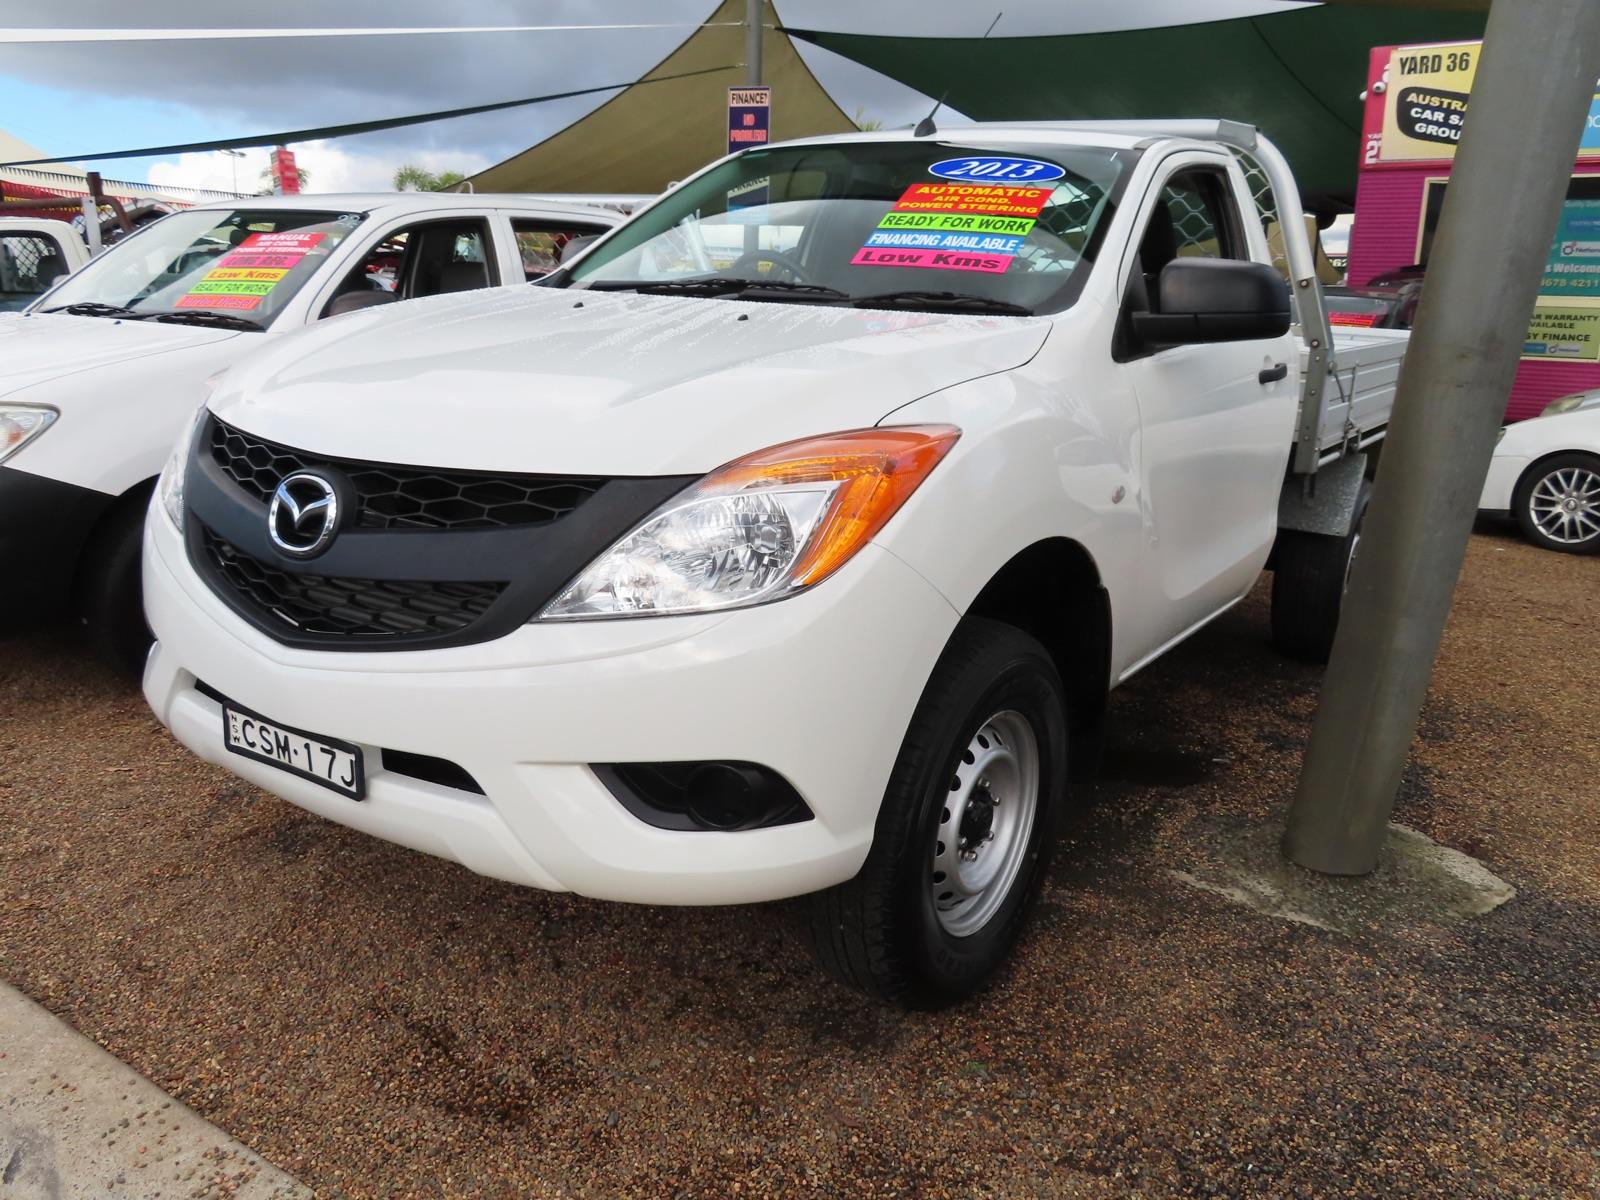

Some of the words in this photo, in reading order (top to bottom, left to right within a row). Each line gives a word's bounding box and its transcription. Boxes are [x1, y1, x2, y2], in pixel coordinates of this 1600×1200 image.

[1399, 55, 1442, 75] YARD
[1447, 52, 1471, 72] 36
[731, 92, 768, 105] FINANCE?
[1410, 108, 1445, 122] CAR
[946, 161, 1045, 179] 2013
[915, 186, 1041, 198] AUTOMATIC
[964, 196, 1012, 204] COND.
[898, 201, 956, 209] POWER
[959, 203, 1039, 214] STEERING
[884, 215, 937, 227] READY
[942, 216, 974, 229] FOR
[978, 218, 1029, 233] WORK
[867, 233, 940, 246] FINANCING
[943, 235, 1019, 251] AVAILABLE
[860, 251, 923, 263] Low
[931, 254, 1001, 269] Kms
[208, 270, 242, 279] Low
[243, 270, 281, 280] Kms
[1542, 333, 1591, 342] FINANCE
[231, 713, 240, 744] NSW
